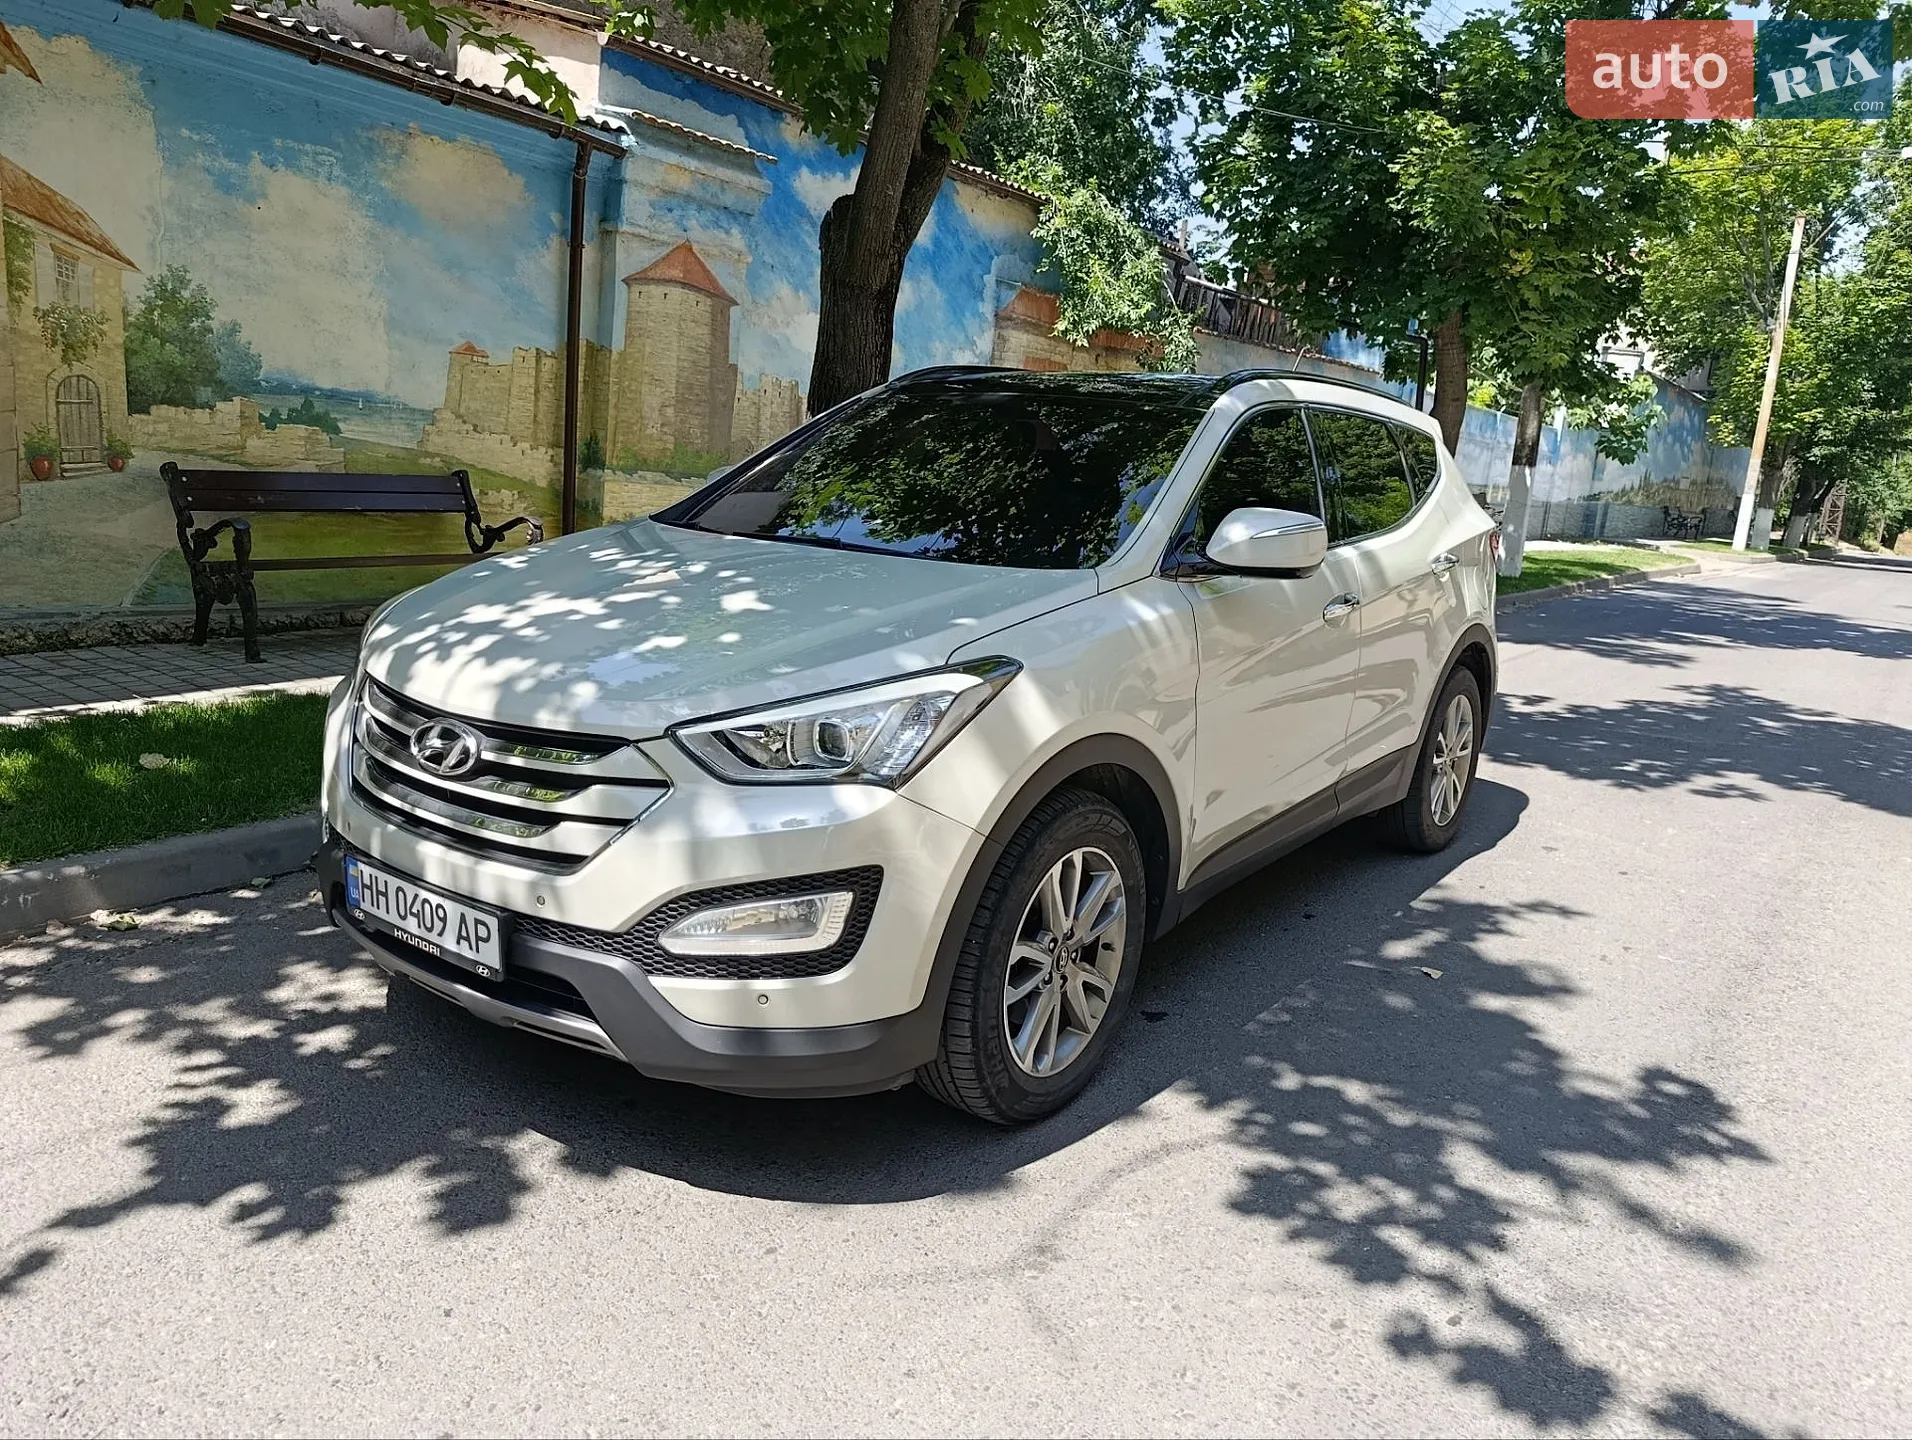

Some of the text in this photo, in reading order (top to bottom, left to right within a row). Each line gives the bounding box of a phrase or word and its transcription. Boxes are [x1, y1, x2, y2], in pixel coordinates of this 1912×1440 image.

[360, 869, 491, 954] HH 0409 AP
[395, 928, 441, 957] HYUNDAI
